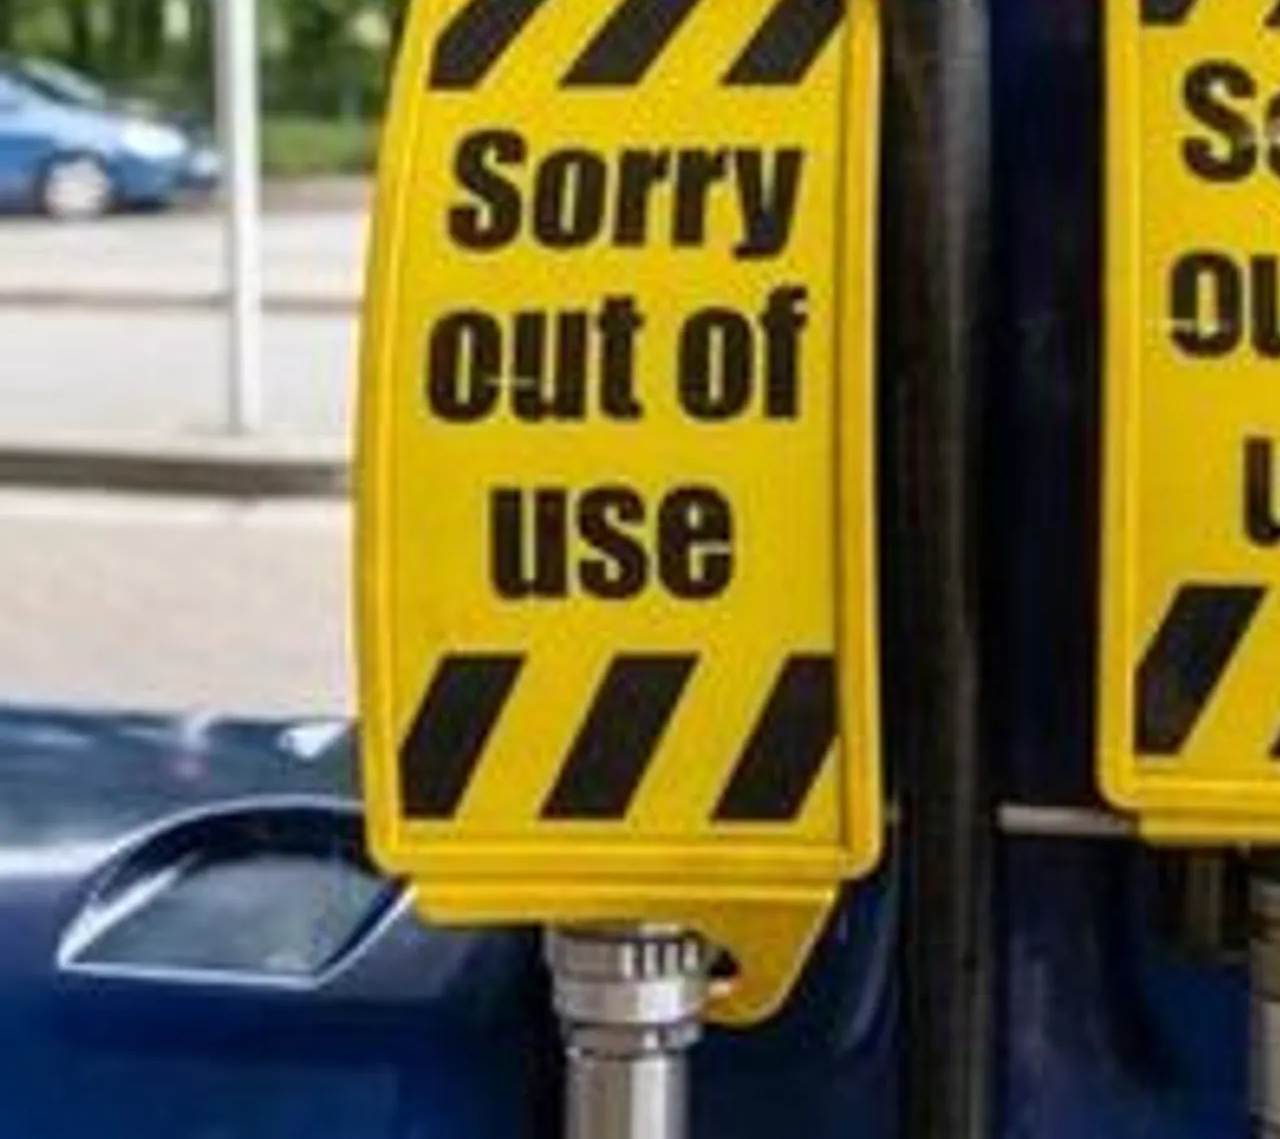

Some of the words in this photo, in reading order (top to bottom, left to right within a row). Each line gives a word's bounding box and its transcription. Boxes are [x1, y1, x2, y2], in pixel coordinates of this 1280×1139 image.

[446, 127, 806, 261] Sorry
[424, 292, 647, 425] out
[676, 283, 810, 423] of
[488, 483, 736, 603] use
